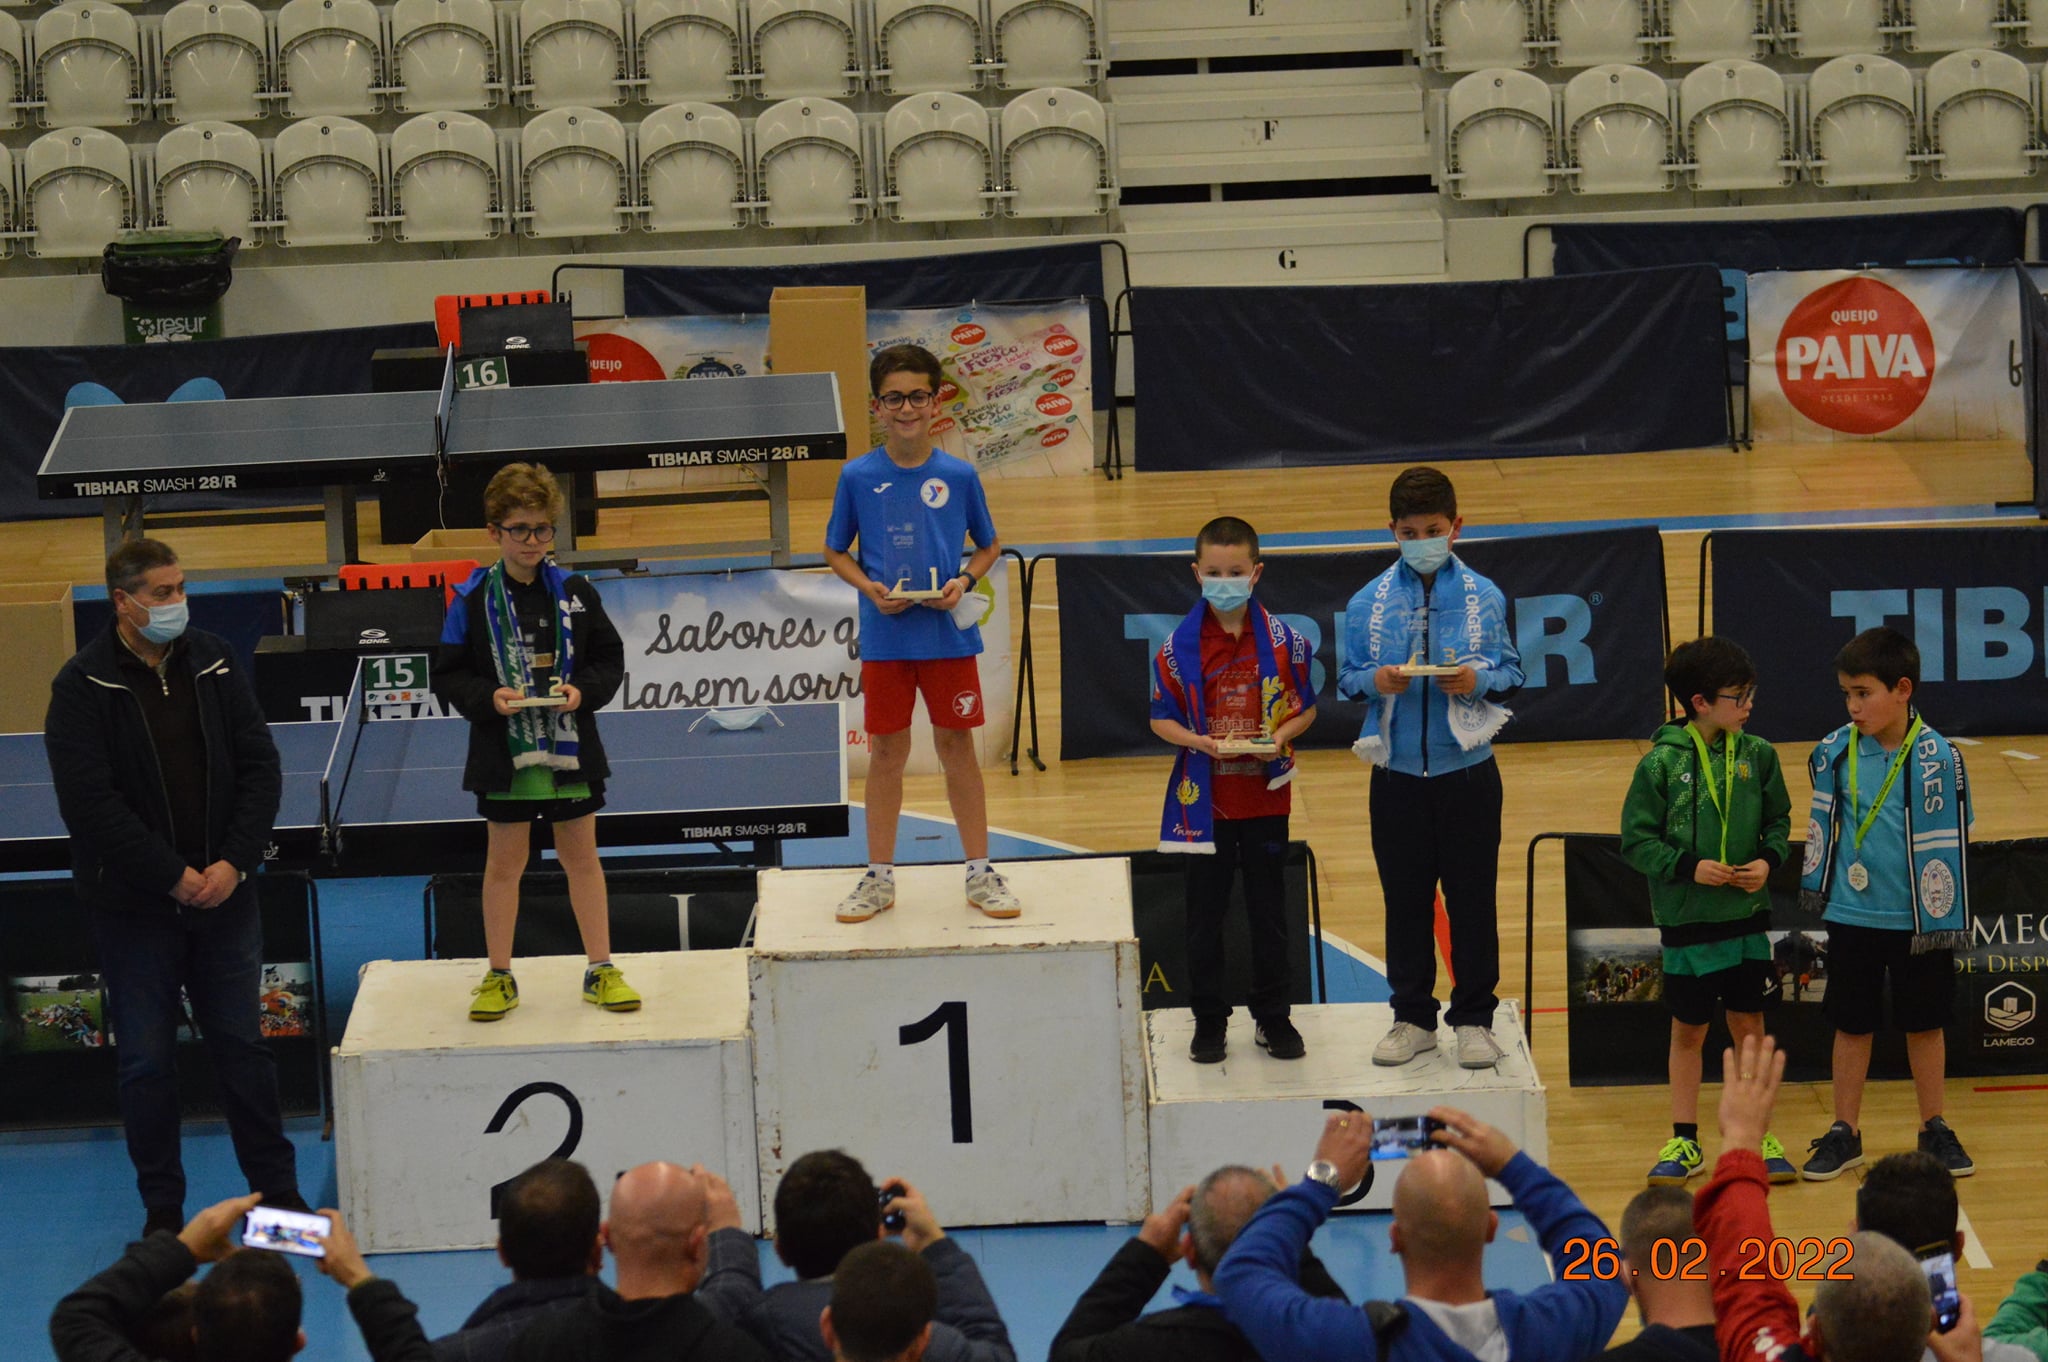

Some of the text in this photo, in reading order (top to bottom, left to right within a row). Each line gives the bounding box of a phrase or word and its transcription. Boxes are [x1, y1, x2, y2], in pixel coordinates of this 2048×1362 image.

[1264, 120, 1278, 140] F
[1278, 250, 1297, 270] G
[1830, 309, 1879, 325] QUEIJO
[1786, 334, 1927, 381] PAIVA
[462, 360, 498, 388] 16
[648, 446, 809, 467] TIBHAR SMASH 28/R
[74, 475, 237, 496] TIBHAR SMASH 28/R
[1462, 573, 1482, 652] DE ORGENS
[645, 611, 826, 656] Sabores
[1369, 601, 1385, 660] CENTRO
[1830, 586, 2048, 682] TIB
[372, 658, 415, 688] 15
[681, 822, 807, 838] TIBHAR SMASH 28/R
[1983, 1037, 2035, 1047] LAMEGO
[898, 1000, 974, 1144] 1
[483, 1081, 583, 1220] 2
